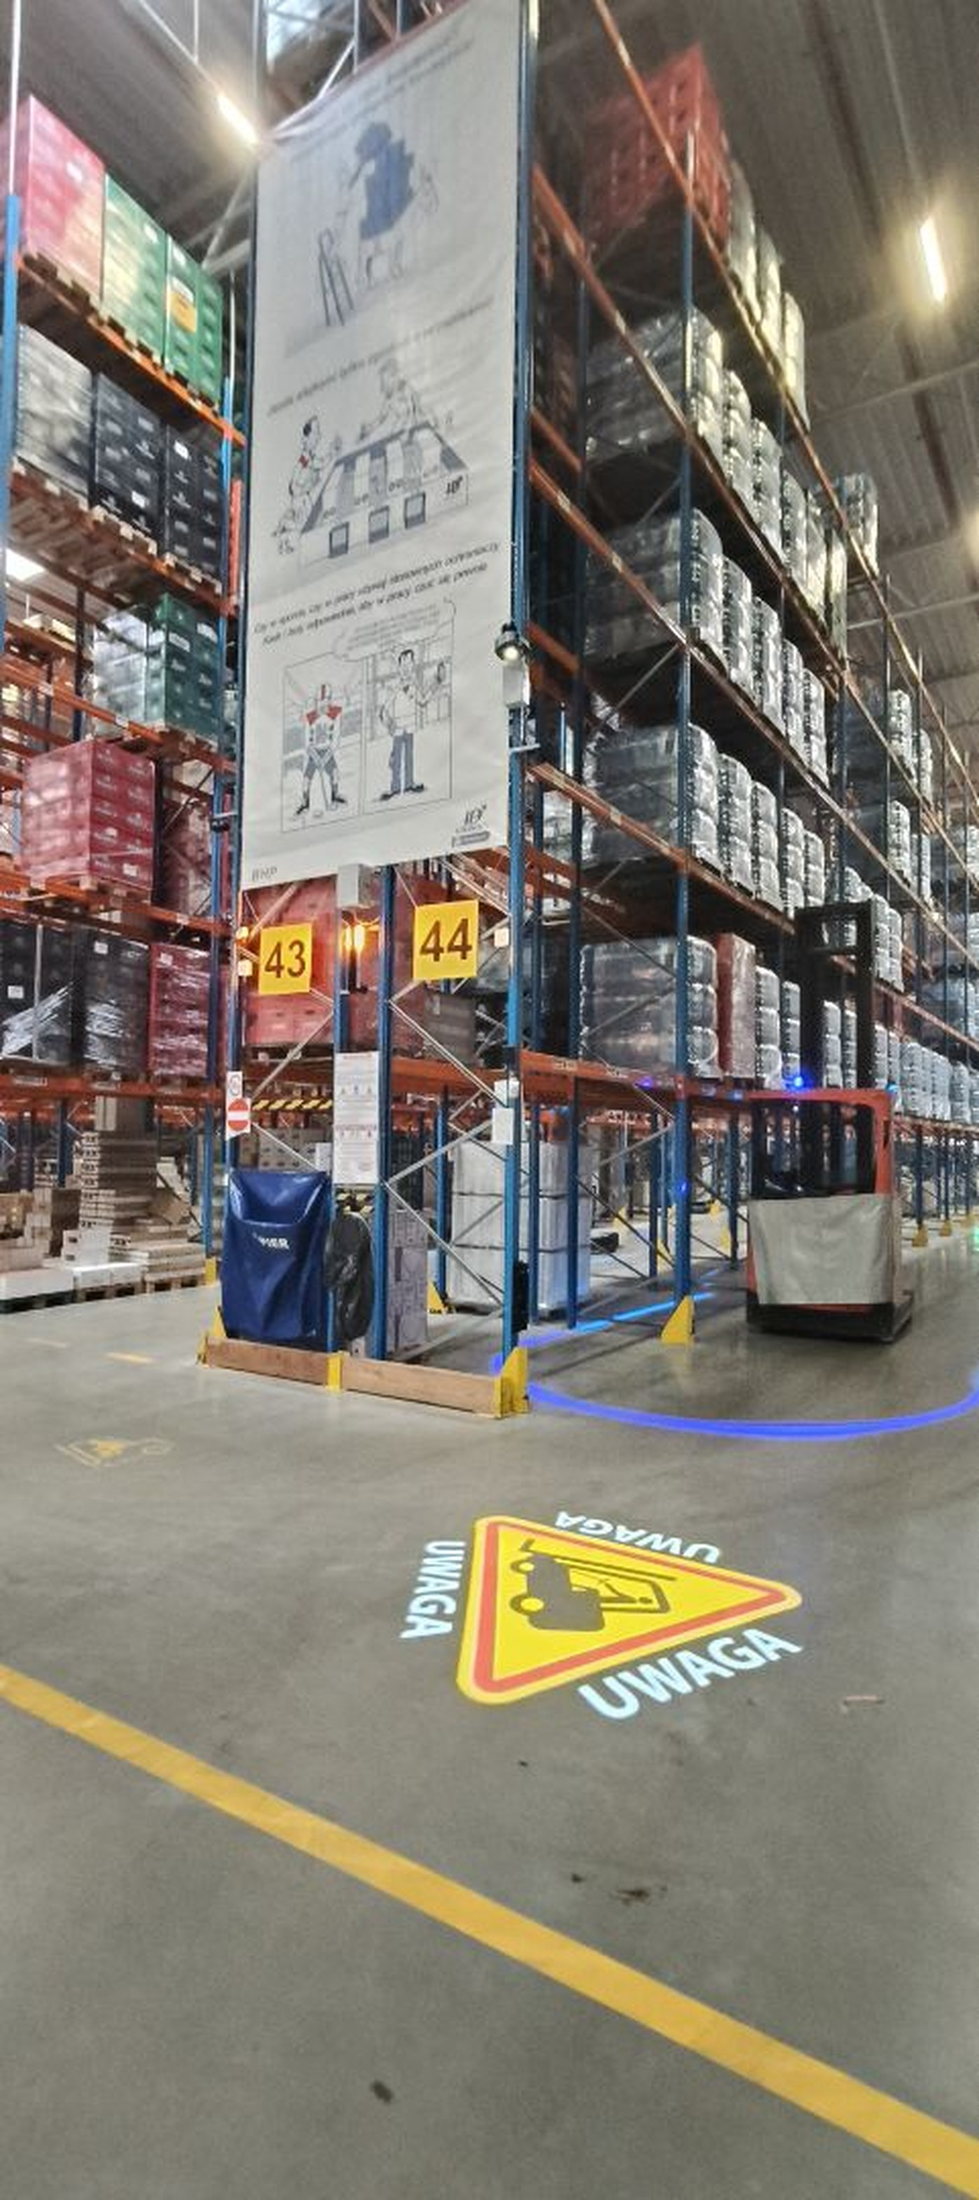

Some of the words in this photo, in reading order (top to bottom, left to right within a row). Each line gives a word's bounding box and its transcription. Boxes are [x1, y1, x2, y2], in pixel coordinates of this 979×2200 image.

[264, 938, 307, 979] 43
[420, 918, 473, 962] 44
[554, 1511, 721, 1563] UWAGA
[400, 1540, 466, 1639] UWAGA
[577, 1628, 803, 1720] UWAGA
